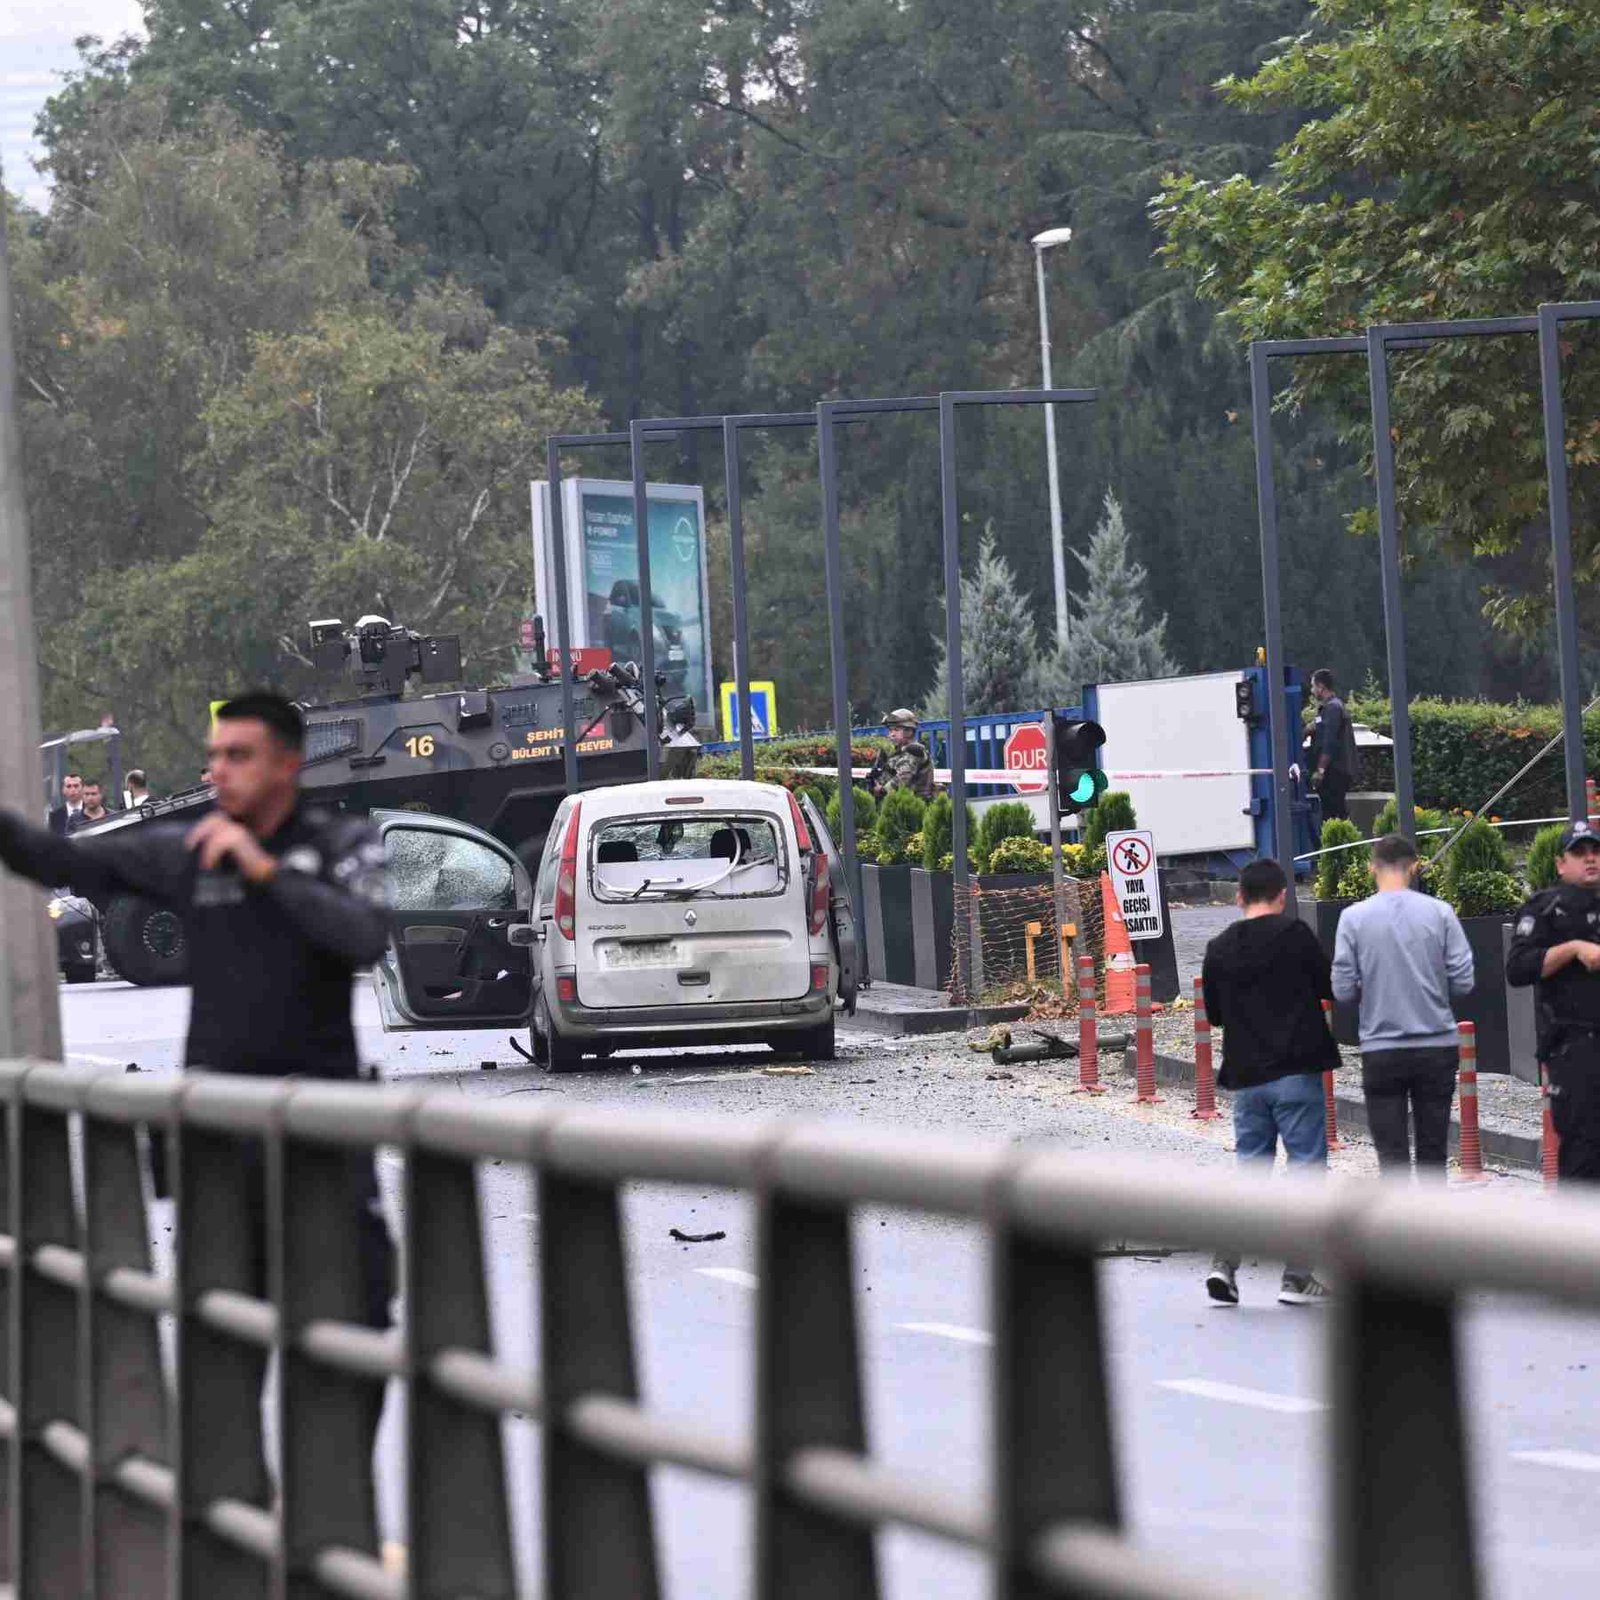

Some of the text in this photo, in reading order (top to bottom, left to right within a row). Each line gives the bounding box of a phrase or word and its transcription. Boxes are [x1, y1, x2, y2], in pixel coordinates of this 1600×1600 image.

[405, 736, 434, 757] 16
[511, 746, 552, 760] BÜLENT
[1011, 748, 1048, 769] DUR
[1125, 879, 1145, 893] YAYA
[1123, 895, 1151, 915] GEÇİŞİ
